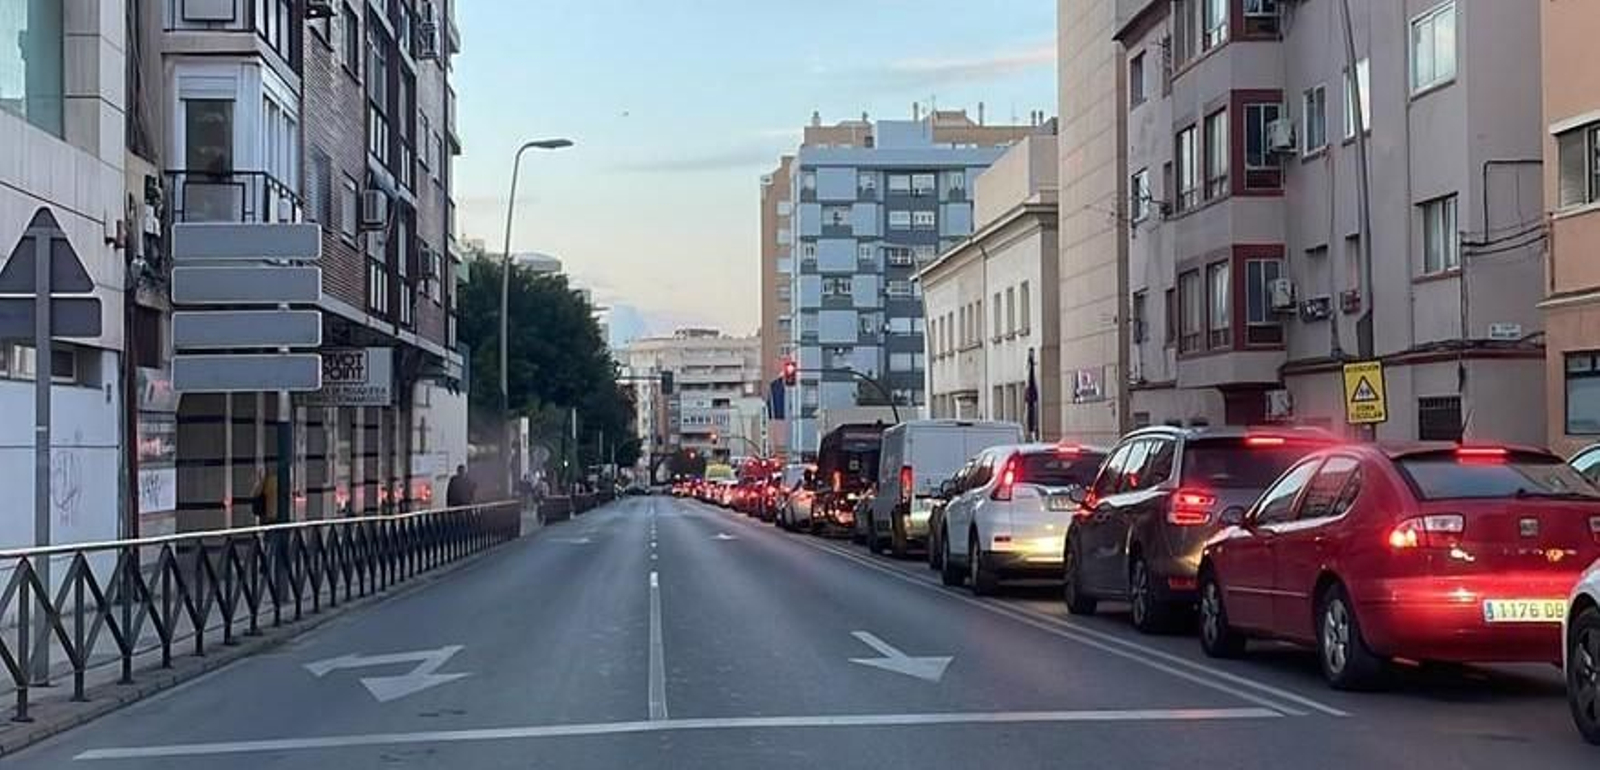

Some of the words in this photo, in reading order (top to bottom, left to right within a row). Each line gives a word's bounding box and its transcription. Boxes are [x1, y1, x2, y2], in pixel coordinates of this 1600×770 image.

[322, 366, 364, 380] POINT
[1500, 602, 1539, 618] 1176
[1544, 602, 1564, 618] DB
